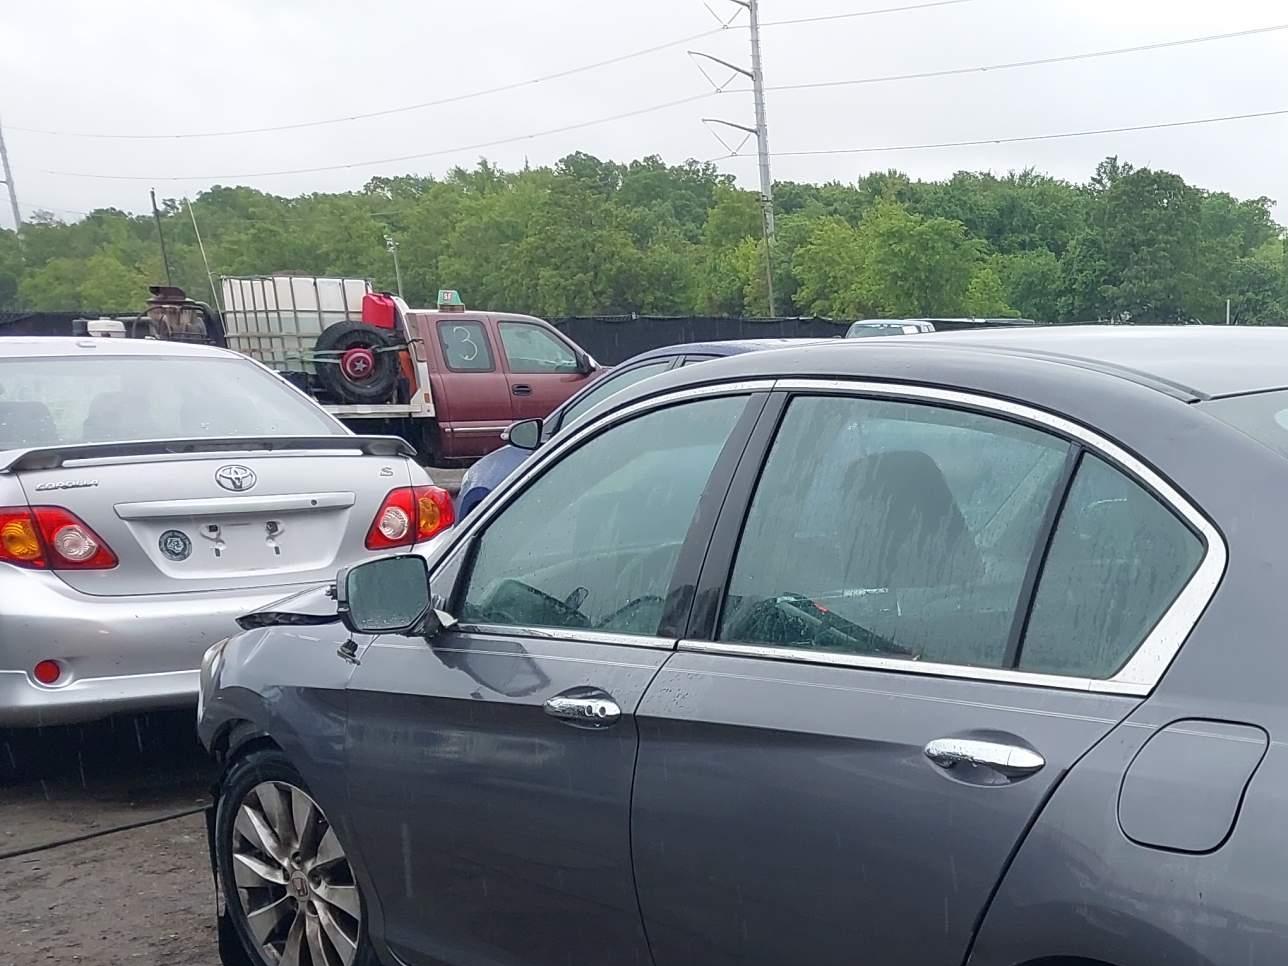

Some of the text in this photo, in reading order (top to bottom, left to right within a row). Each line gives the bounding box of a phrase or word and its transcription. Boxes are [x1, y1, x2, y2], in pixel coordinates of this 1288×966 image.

[452, 326, 478, 361] 3
[380, 466, 394, 477] S
[35, 479, 99, 492] COROLLA
